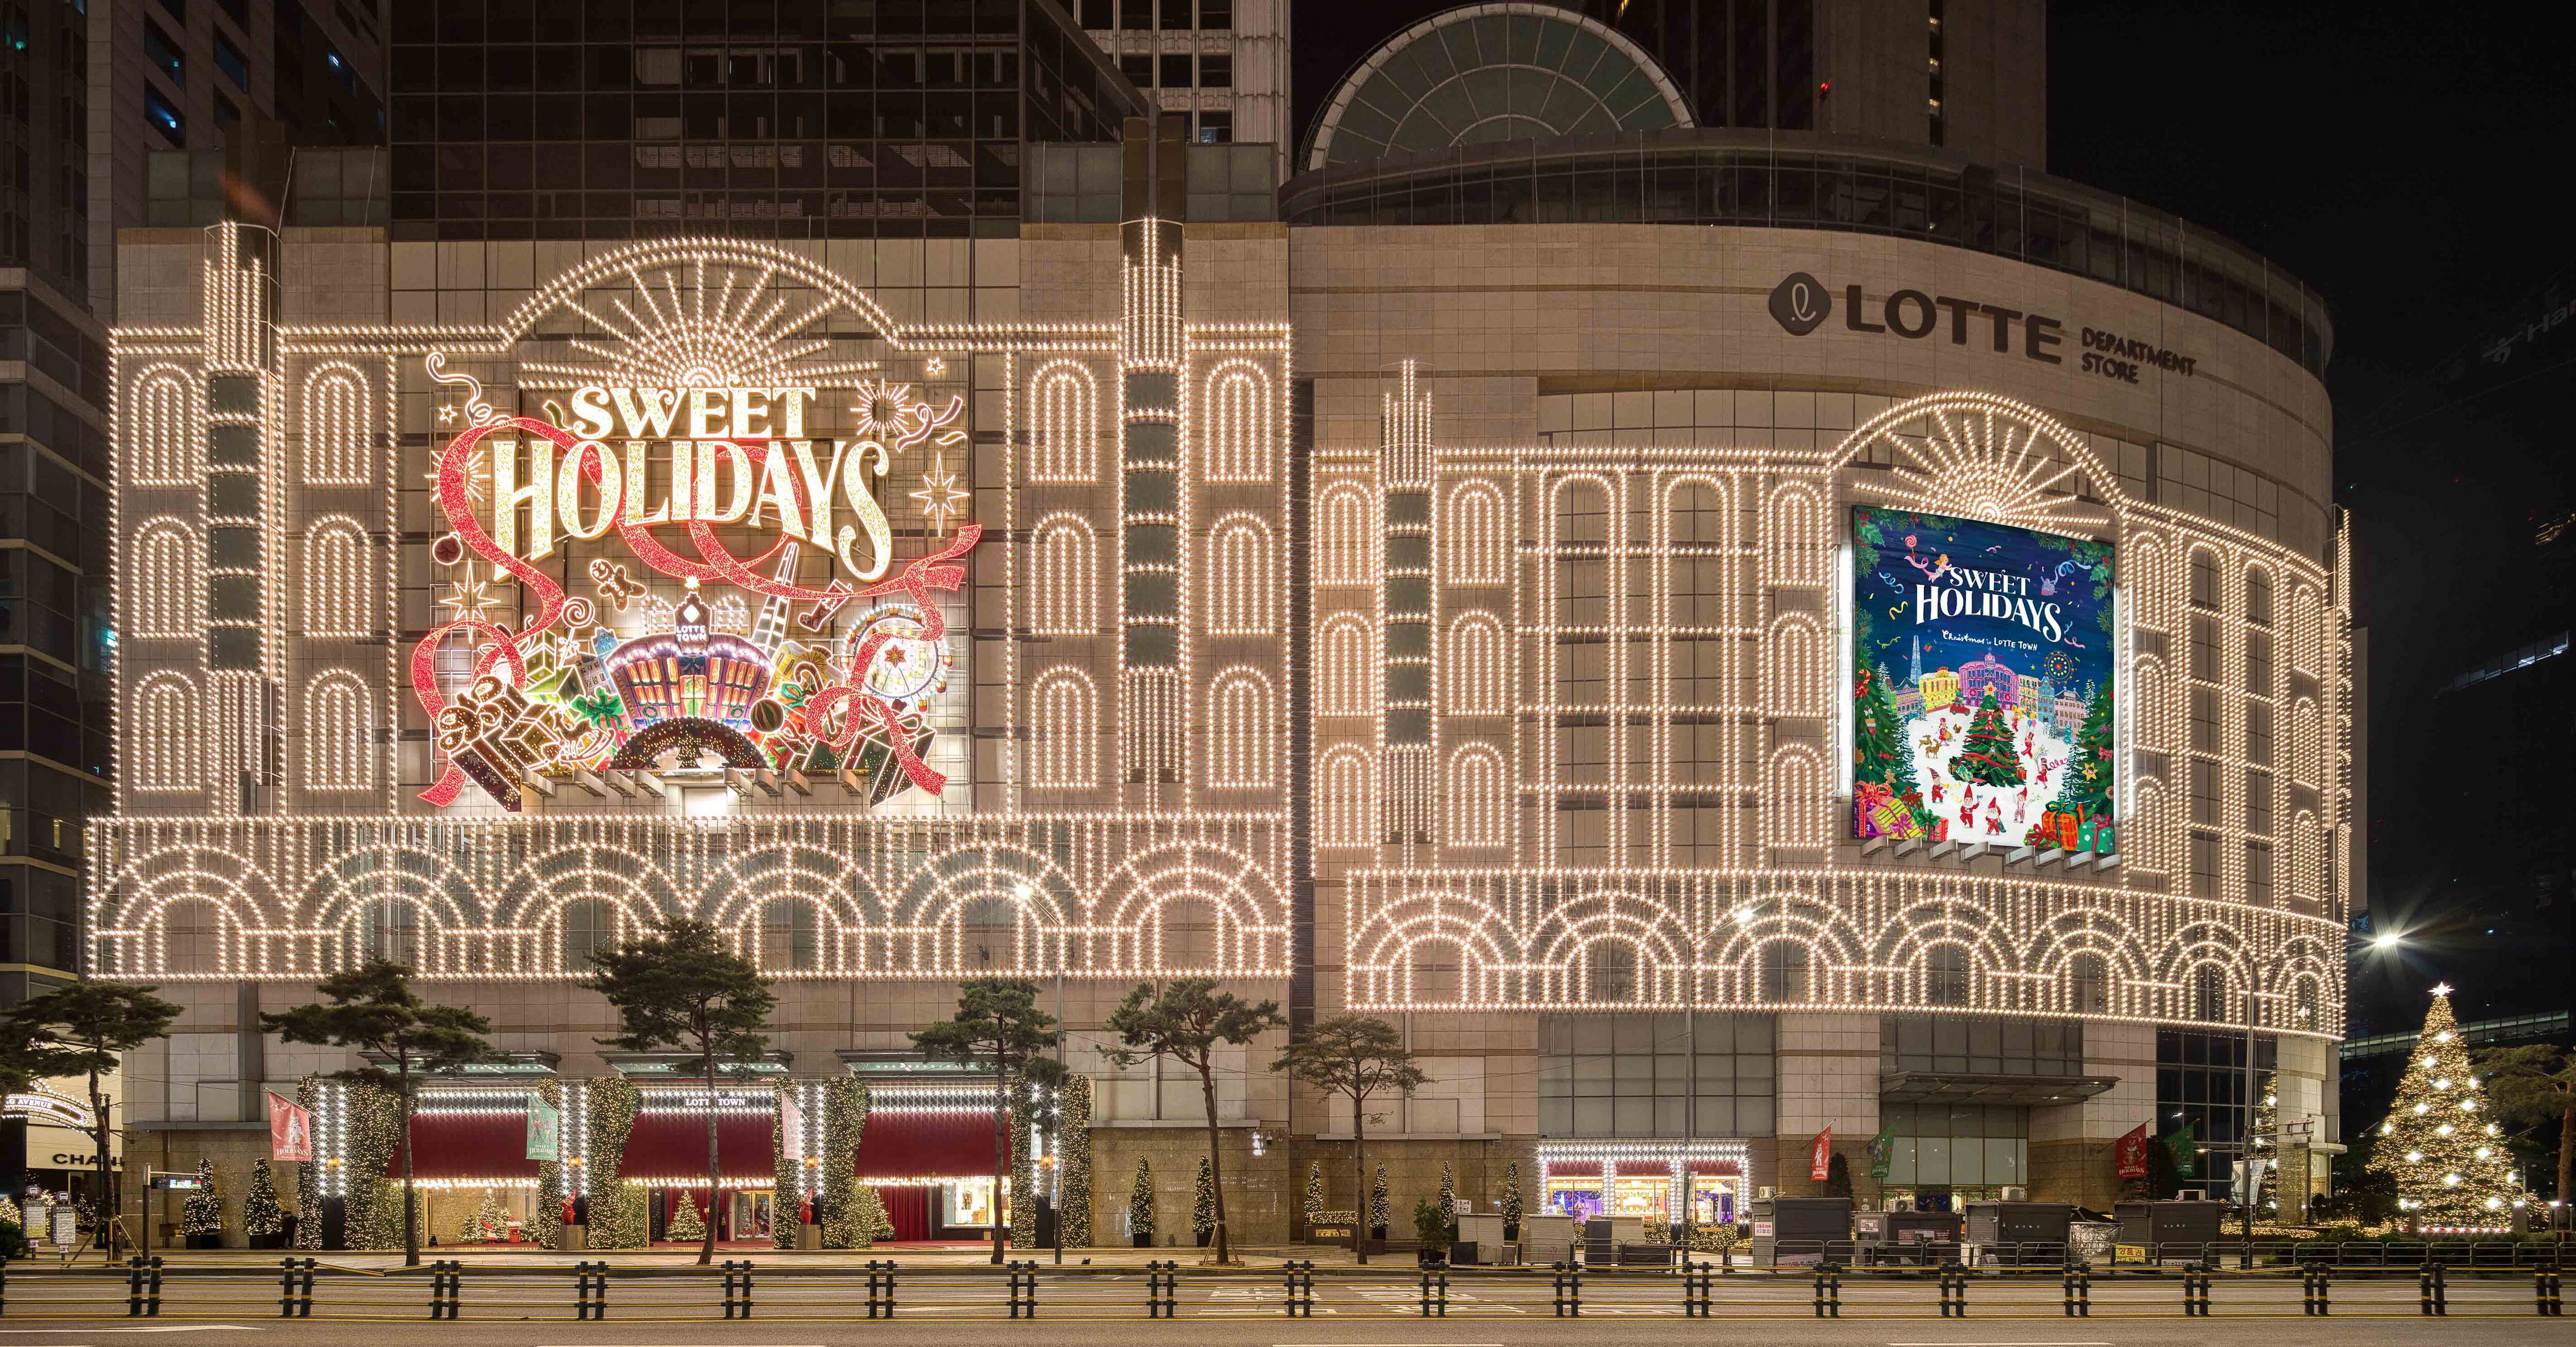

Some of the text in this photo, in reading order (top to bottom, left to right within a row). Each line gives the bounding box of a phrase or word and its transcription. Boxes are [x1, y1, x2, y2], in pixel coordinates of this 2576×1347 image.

[1846, 284, 2062, 364] LOTTE
[2081, 326, 2196, 377] DEPARTMENT
[2081, 350, 2139, 384] STORE
[571, 376, 817, 440] SWEET
[489, 438, 894, 583] HOLIDAYS
[1949, 567, 2030, 596] SWEET
[1915, 584, 2062, 643] HOLIDAYS
[676, 625, 707, 634] LOTTE
[676, 633, 707, 642] TOWN
[1942, 630, 1985, 645] Christmas
[1993, 637, 2016, 648] LOTTE
[2019, 641, 2038, 651] TOWN
[277, 1148, 309, 1156] HOLIDAYS
[2118, 1248, 2142, 1256] 상품권
